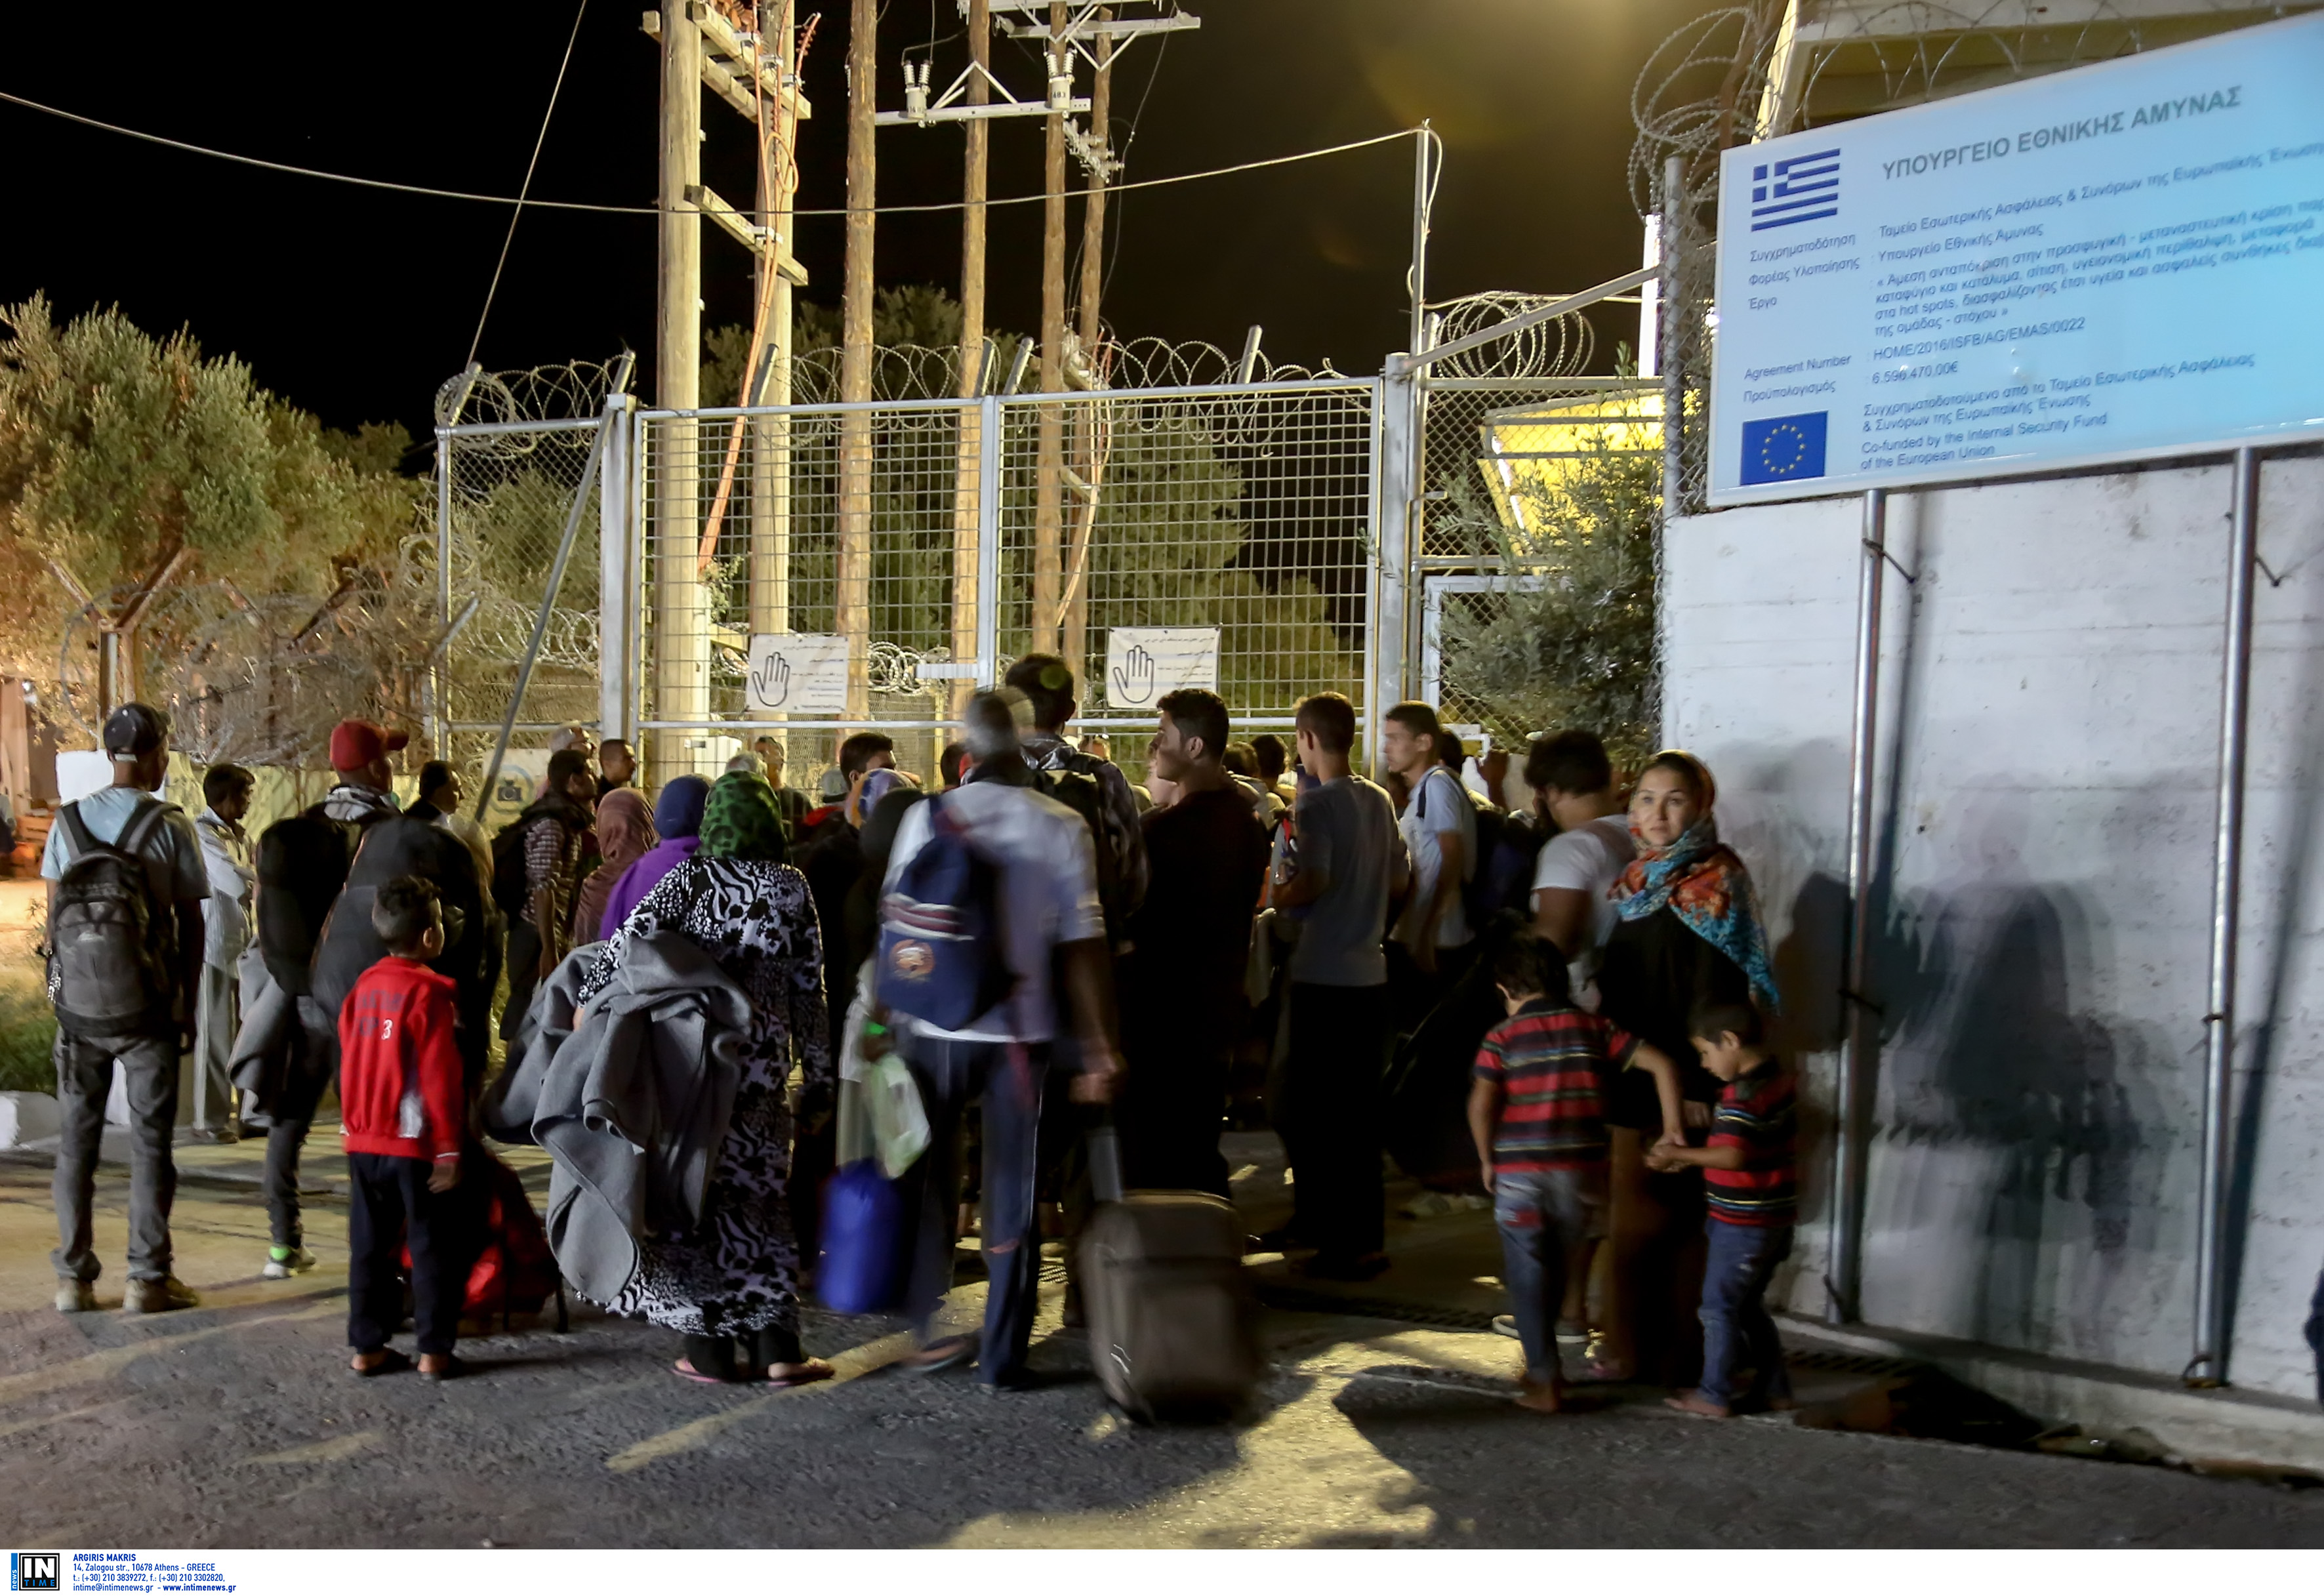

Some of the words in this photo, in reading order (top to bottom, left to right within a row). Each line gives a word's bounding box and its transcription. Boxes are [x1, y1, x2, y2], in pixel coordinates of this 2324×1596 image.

[1883, 136, 2010, 180] ΥΠΟΥΡΓΕΙΟ
[2017, 111, 2125, 153] ΕΘΝΙΚΗΣ
[2131, 85, 2241, 129] ΑΜΥΝΑΣ
[1750, 234, 1856, 262] Συγχρηματοδότηση
[1879, 220, 1917, 238] Ταμείο
[1921, 207, 1992, 230] Εσωτερικής
[1995, 193, 2063, 217] Ασφάλειας
[2068, 188, 2077, 200] &
[2147, 172, 2169, 187] της
[1748, 270, 1790, 285] Φορέας
[1793, 257, 1860, 277] Υλοποίησης
[1878, 243, 1941, 262] Υπουργείο
[1944, 232, 1992, 251] Εθνικής
[1748, 297, 1778, 310] Έργο
[1930, 256, 2008, 278] ανταπόκριση
[2012, 249, 2041, 264] στην
[1875, 309, 1896, 320] στα
[1900, 304, 1919, 316] hot
[2089, 268, 2124, 287] υγεία
[2129, 265, 2149, 278] και
[1876, 285, 1936, 304] καταφύγιο
[1940, 281, 1957, 293] και
[1744, 362, 1803, 381] Agreement
[1806, 355, 1852, 370] Number
[1873, 316, 2086, 361] HOME/2016/ISFB/AG/EMAS/0022
[1875, 325, 1893, 338] της
[1897, 316, 1942, 333] ομάδας
[1953, 308, 1997, 325] στόχου
[1864, 388, 2000, 417] Συγχρηματοδοτούμενο
[2003, 383, 2029, 398] από
[2050, 376, 2092, 391] Ταμείο
[2095, 364, 2176, 386] Εσωτερικής
[2178, 354, 2255, 375] Ασφάλειας
[1862, 436, 1923, 453] Co-funded
[1926, 434, 1940, 448] by
[1944, 430, 1963, 443] the
[1968, 423, 2014, 440] Internal
[2018, 418, 2069, 435] Security
[2073, 413, 2107, 427] Fund
[1863, 420, 1871, 432] &
[1933, 411, 1953, 425] της
[1861, 459, 1872, 470] of
[1875, 455, 1894, 468] the
[1896, 449, 1955, 467] European
[1959, 445, 1995, 458] Union
[382, 1018, 393, 1040] 3
